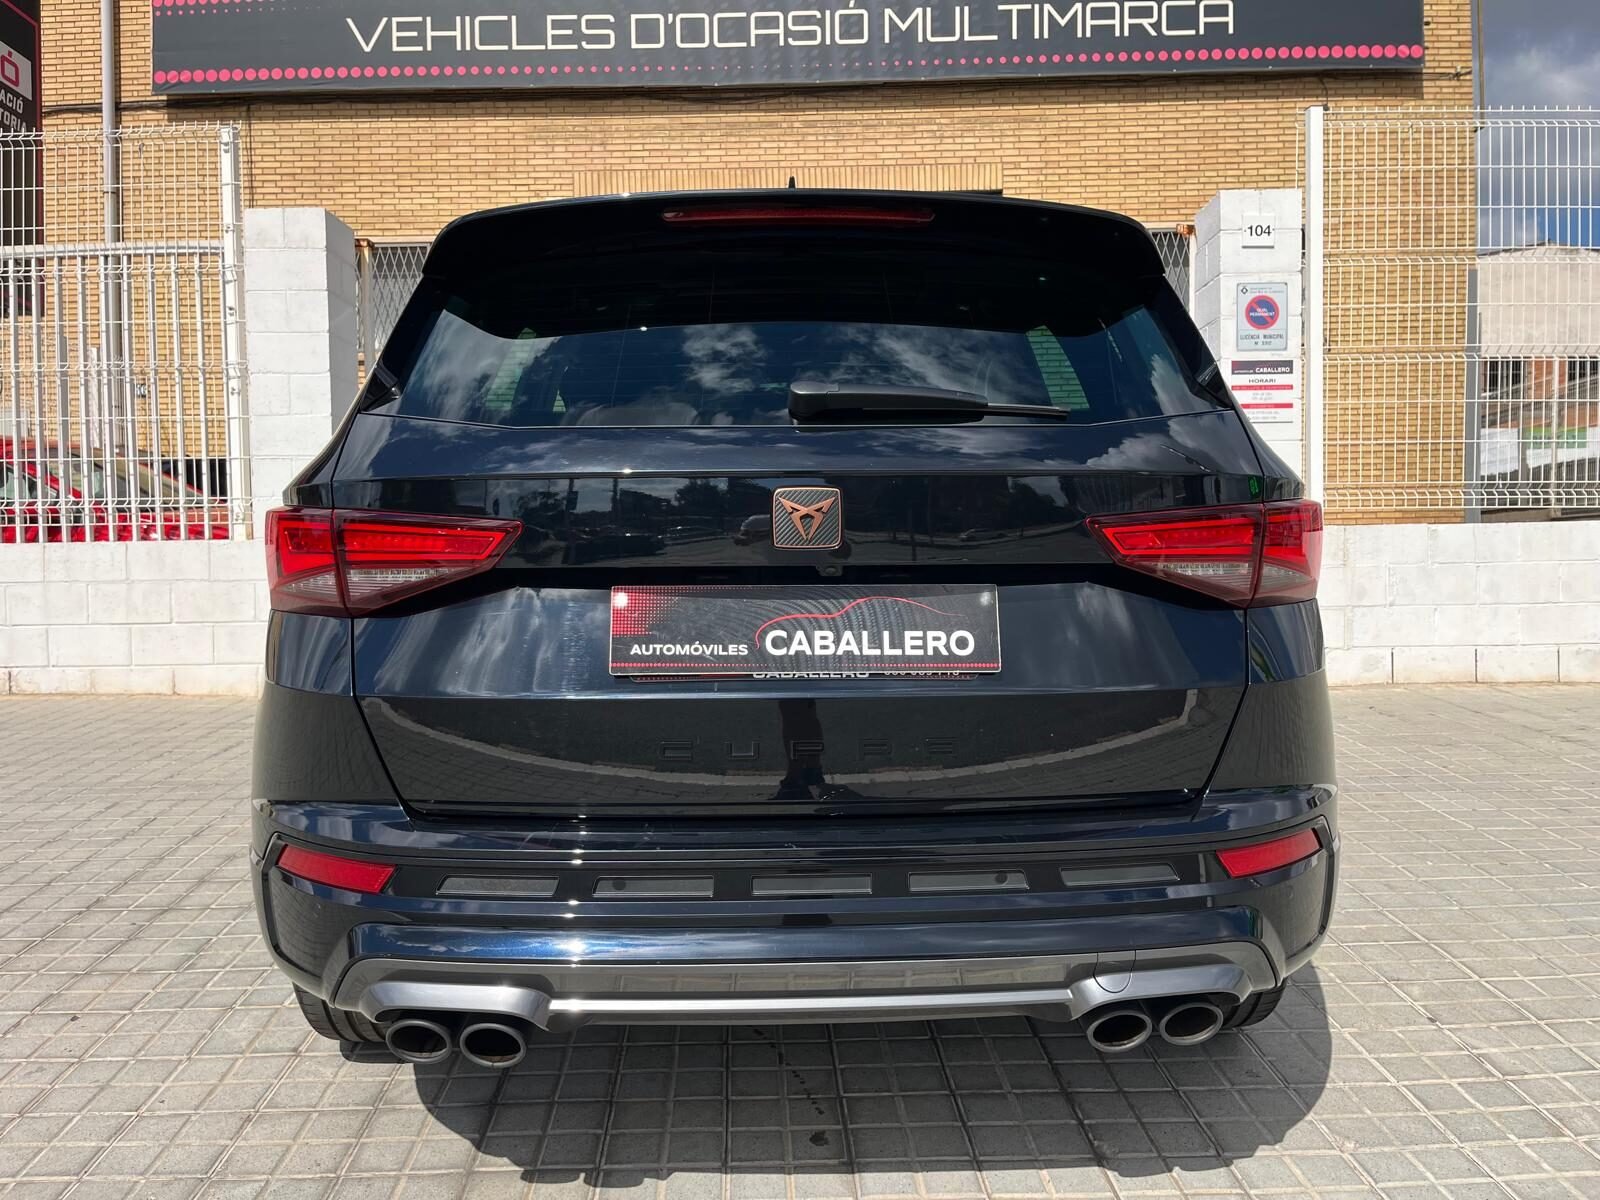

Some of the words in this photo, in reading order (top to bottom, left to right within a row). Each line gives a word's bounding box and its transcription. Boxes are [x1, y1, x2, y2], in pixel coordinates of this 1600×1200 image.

[346, 15, 616, 53] VEHICLES
[630, 0, 869, 49] D'OCASIÓ
[884, 0, 1235, 44] MULTIMARCA
[1247, 224, 1273, 237] 104
[1255, 366, 1290, 374] CABALLERO
[629, 639, 749, 657] AUTOMÓVILES
[765, 629, 976, 657] CABALLERO
